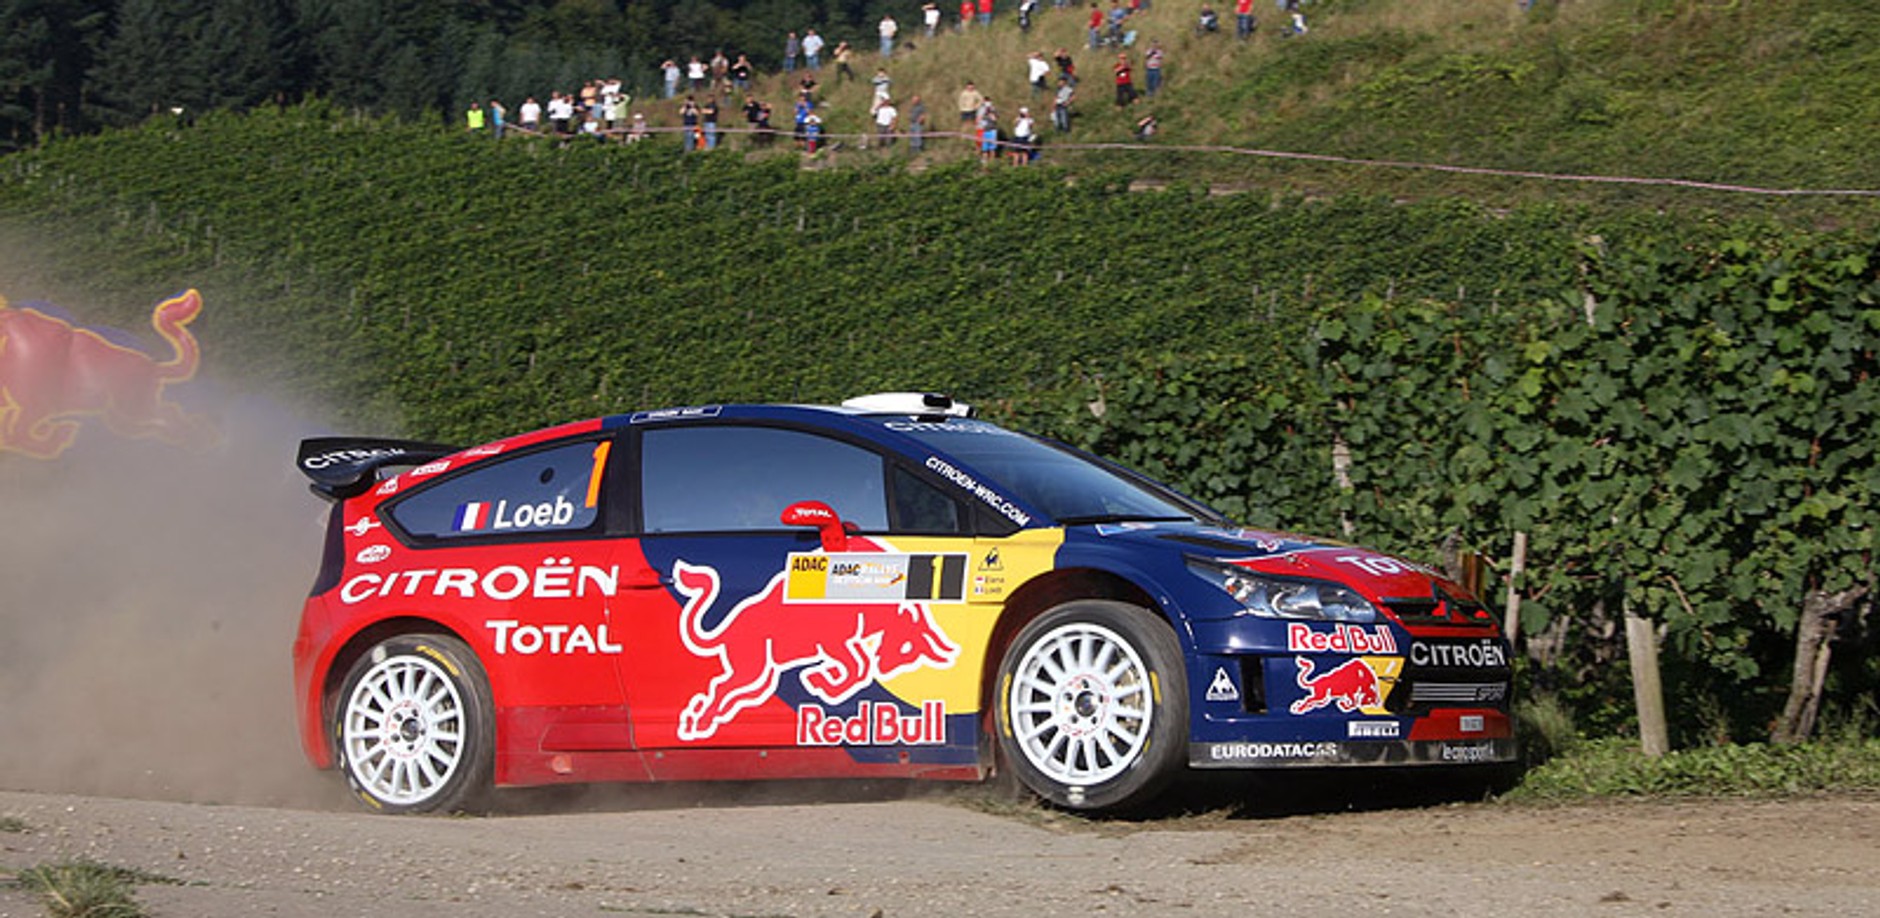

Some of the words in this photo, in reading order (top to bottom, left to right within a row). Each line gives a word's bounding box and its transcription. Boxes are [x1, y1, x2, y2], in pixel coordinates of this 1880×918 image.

[584, 441, 612, 509] 1
[493, 496, 574, 529] Loeb
[795, 507, 833, 518] TOTAL
[340, 556, 619, 604] CITROËN
[791, 556, 828, 572] ADAC
[832, 563, 861, 577] ADAC
[931, 555, 944, 600] 1
[485, 620, 623, 654] TOTAL
[1288, 622, 1349, 651] Red
[1350, 624, 1398, 653] Bull
[1410, 638, 1506, 667] CITROËN
[798, 702, 871, 744] Red
[874, 701, 946, 744] Bull
